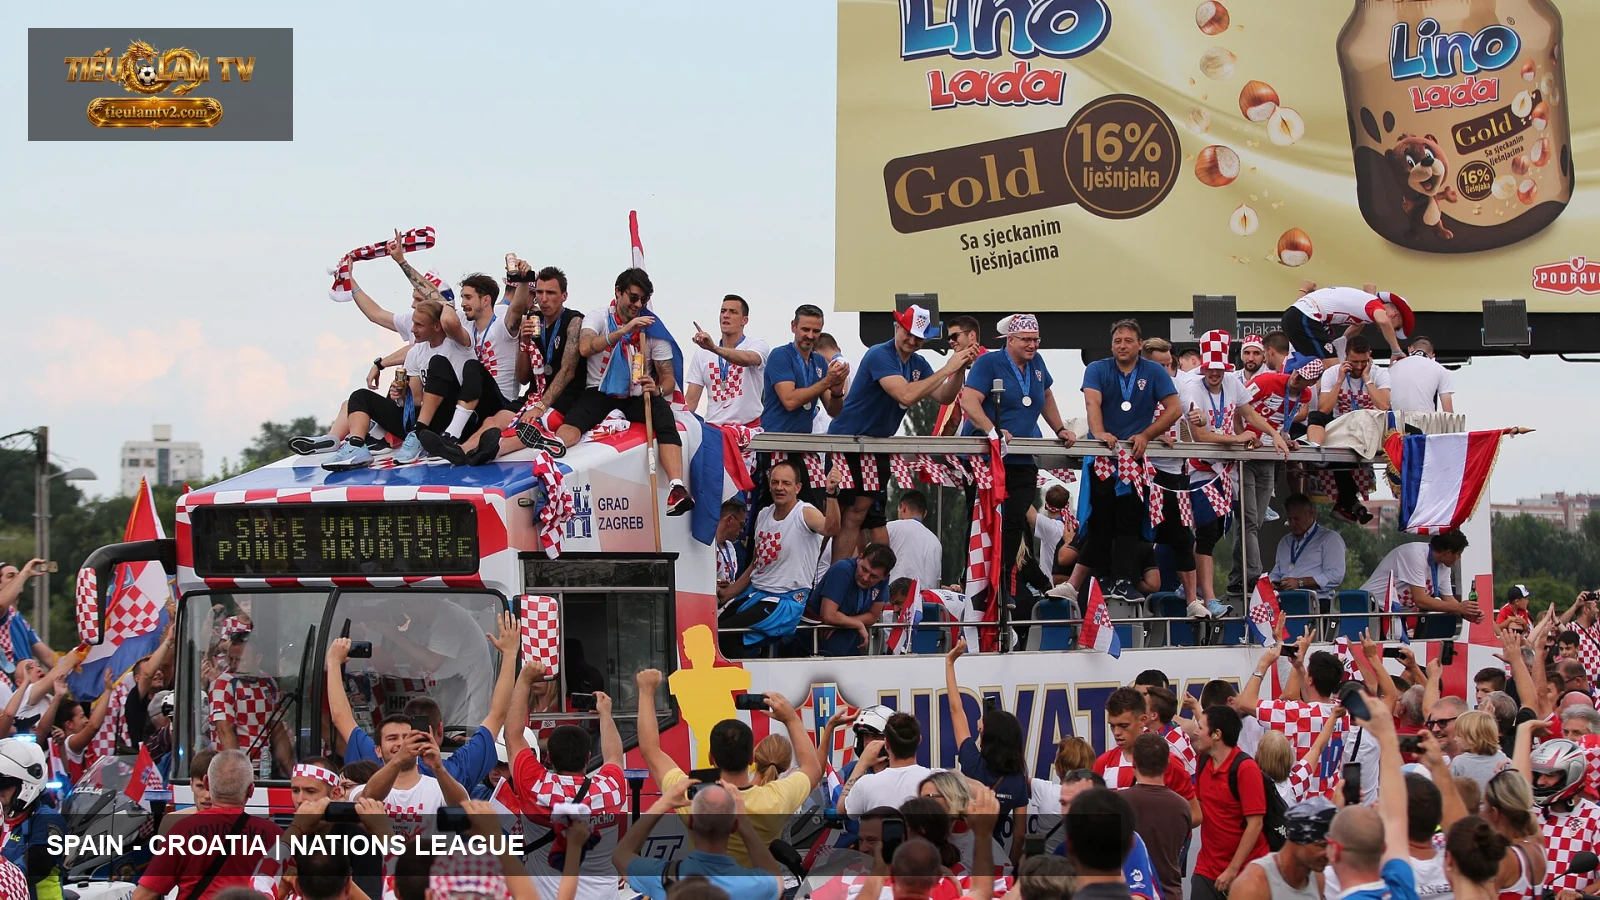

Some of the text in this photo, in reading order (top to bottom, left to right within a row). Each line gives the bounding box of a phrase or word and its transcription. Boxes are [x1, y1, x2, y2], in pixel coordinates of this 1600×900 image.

[899, 0, 1112, 60] Lino
[1389, 17, 1522, 81] Lino
[926, 60, 1067, 110] Lada
[1408, 75, 1499, 112] Lada
[1076, 122, 1162, 163] 16%
[1455, 112, 1513, 147] Gold
[894, 147, 1044, 216] Gold
[1083, 165, 1160, 192] lješnjaka
[1461, 167, 1490, 186] 16%
[960, 218, 1062, 251] Sa sjeckanim
[970, 244, 1060, 275] lješnjacima
[1540, 271, 1600, 285] PODRAV
[597, 497, 629, 512] GRAD
[236, 518, 306, 538] SRCE
[598, 516, 644, 531] ZAGREB
[321, 537, 473, 560] HRVATSKE
